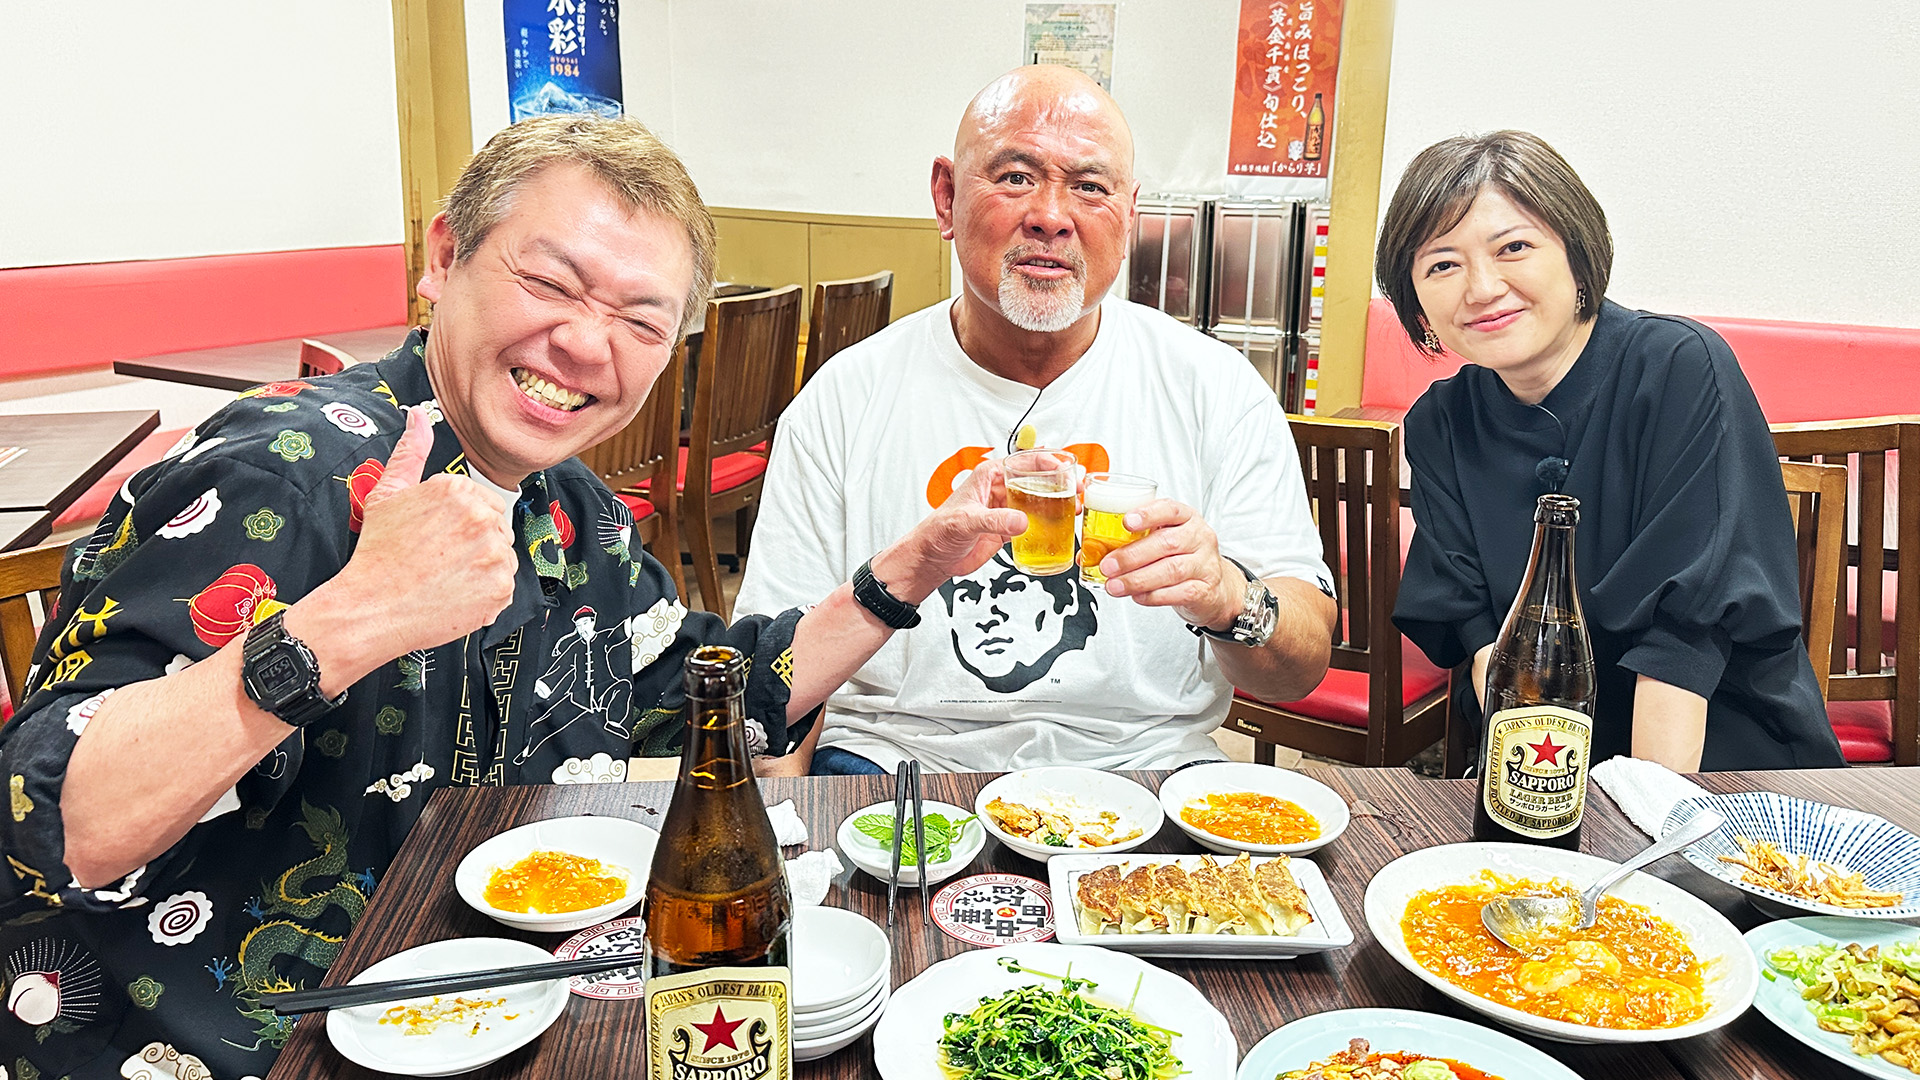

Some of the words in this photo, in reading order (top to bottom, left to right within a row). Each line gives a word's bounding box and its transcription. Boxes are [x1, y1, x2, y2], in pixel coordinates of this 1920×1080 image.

[1291, 2, 1315, 119] 旨みほっこり、
[550, 63, 580, 77] 1984
[1504, 719, 1531, 731] JAPAN'S
[1535, 717, 1567, 728] OLDEST
[1509, 771, 1574, 792] SAPPORO
[1509, 789, 1545, 804] LAGER
[1548, 793, 1573, 804] BEER
[1510, 798, 1571, 812] サッポロラガービール
[1532, 815, 1567, 828] SAPPORO
[660, 991, 694, 1007] JAPAN'S
[697, 983, 743, 998] OLDEST
[747, 984, 779, 997] BRAND
[691, 1055, 725, 1063] SINCE
[727, 1050, 750, 1062] 1876
[674, 1055, 767, 1080] SAPPORO
